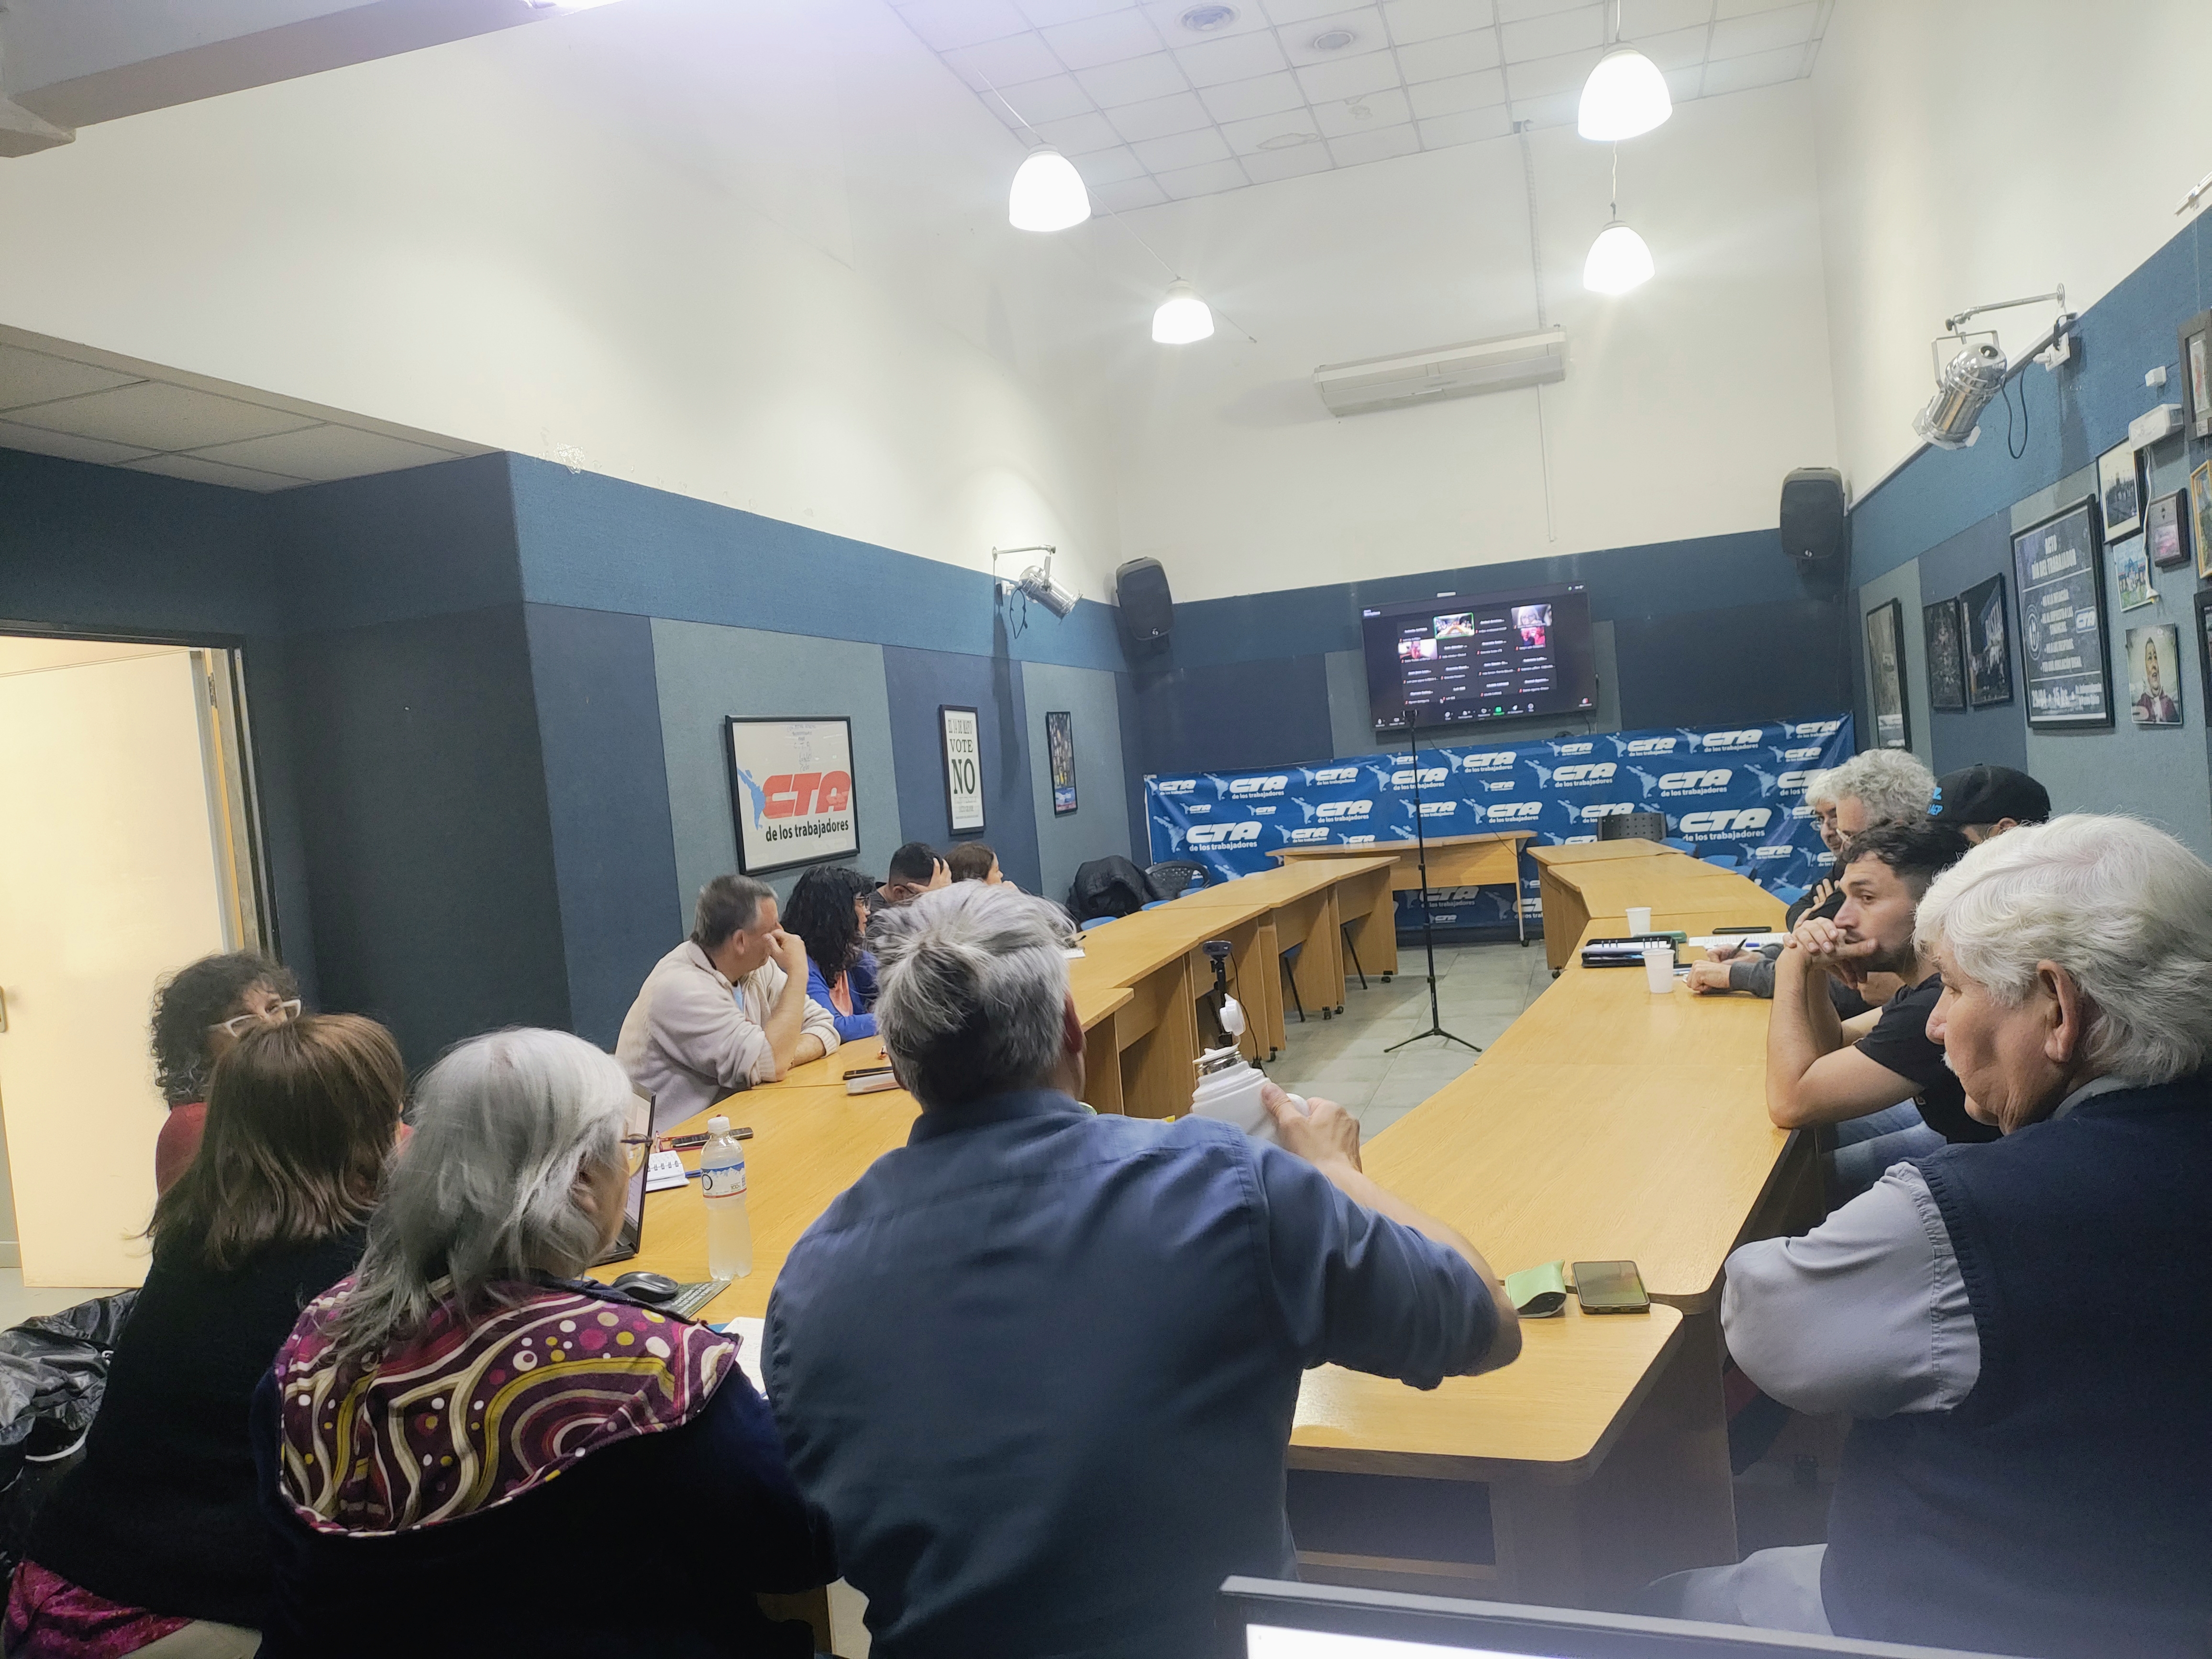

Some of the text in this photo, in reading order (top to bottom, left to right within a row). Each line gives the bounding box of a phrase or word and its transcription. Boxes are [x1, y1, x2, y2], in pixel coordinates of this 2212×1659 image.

[1795, 720, 1841, 734] CTA
[1703, 729, 1763, 746] CTA
[950, 739, 973, 752] VOTE
[1561, 743, 1593, 753] CTA
[1627, 738, 1676, 752] CTA
[1463, 752, 1516, 767] CTA
[1785, 747, 1822, 758] CTA
[951, 758, 975, 794] NO
[1315, 767, 1359, 781] CTA
[1391, 767, 1449, 785] CTA
[1553, 763, 1617, 781] CTA
[1659, 769, 1733, 789] CTA
[1159, 780, 1196, 791] CTA
[1229, 775, 1288, 793] CTA
[1574, 778, 1613, 786] trabajadores
[763, 771, 851, 819] CTA
[1249, 790, 1284, 799] trabajadores
[1682, 787, 1727, 796] trabajadores
[1316, 800, 1373, 817] CTA
[1419, 801, 1457, 813] CTA
[1487, 802, 1542, 818] CTA
[1581, 802, 1635, 818] CTA
[1334, 814, 1369, 822] trabajadores
[1680, 807, 1772, 833] CTA
[766, 818, 849, 842] de los trabajadores
[1186, 821, 1262, 843] CTA
[1291, 827, 1329, 839] CTA
[1709, 830, 1765, 841] trabajadores
[1211, 841, 1257, 851] trabajadores
[1756, 845, 1793, 856] CTA
[1419, 886, 1479, 901] CTA
